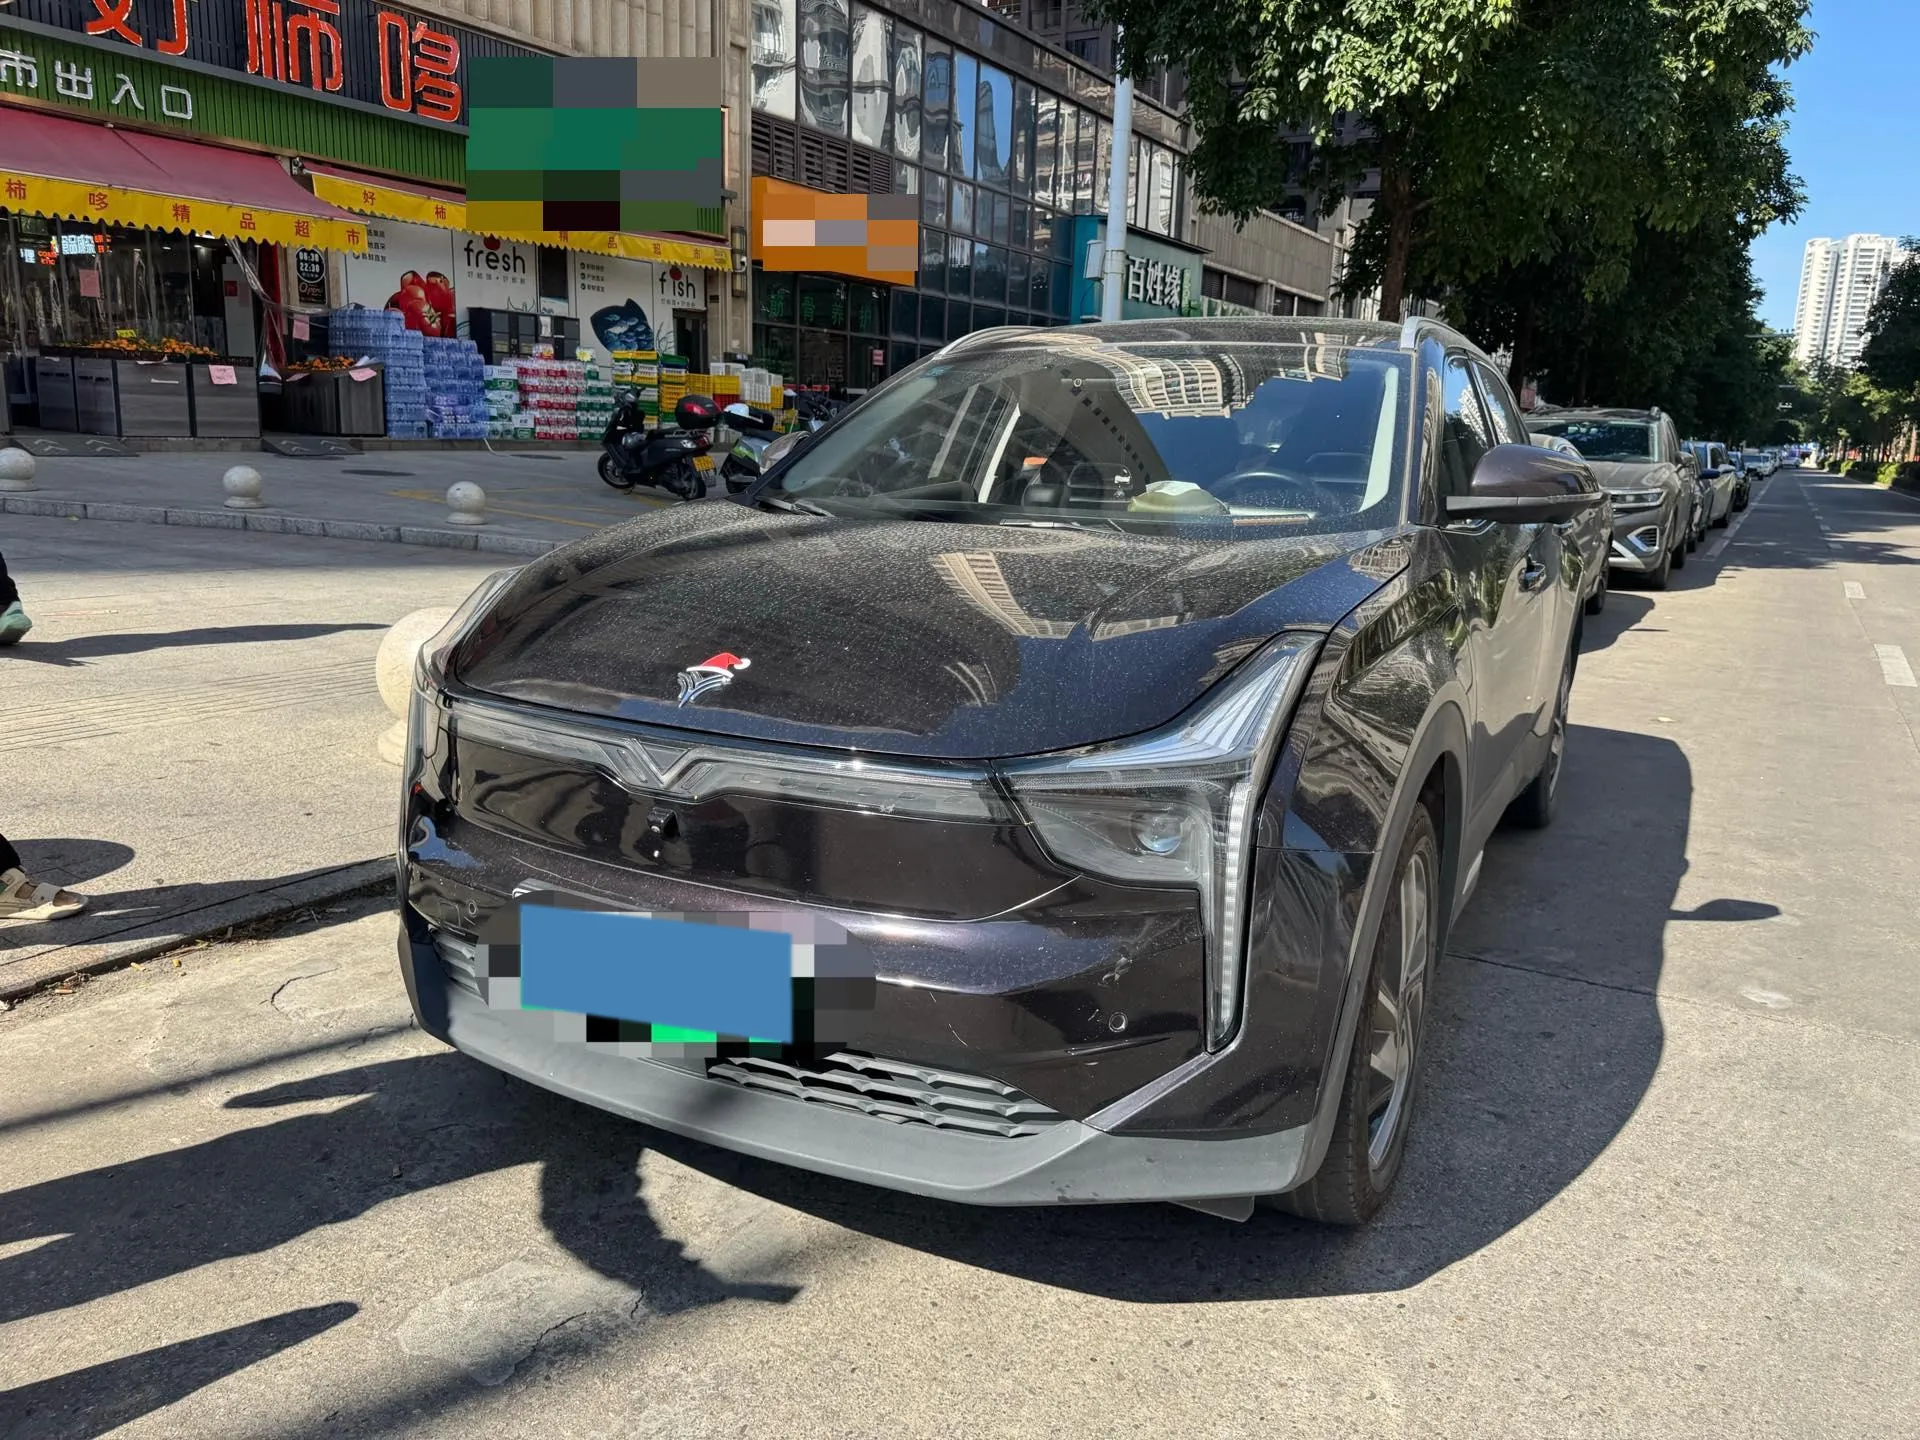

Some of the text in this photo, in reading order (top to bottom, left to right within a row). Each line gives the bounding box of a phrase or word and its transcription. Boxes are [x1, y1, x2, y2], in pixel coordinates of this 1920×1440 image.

[0, 51, 192, 120] 市出入口
[5, 178, 360, 246] 柿哆精品超市
[300, 262, 321, 273] 22:30
[464, 240, 526, 274] fresh
[659, 272, 696, 299] fish
[1127, 255, 1182, 309] 百姓缘
